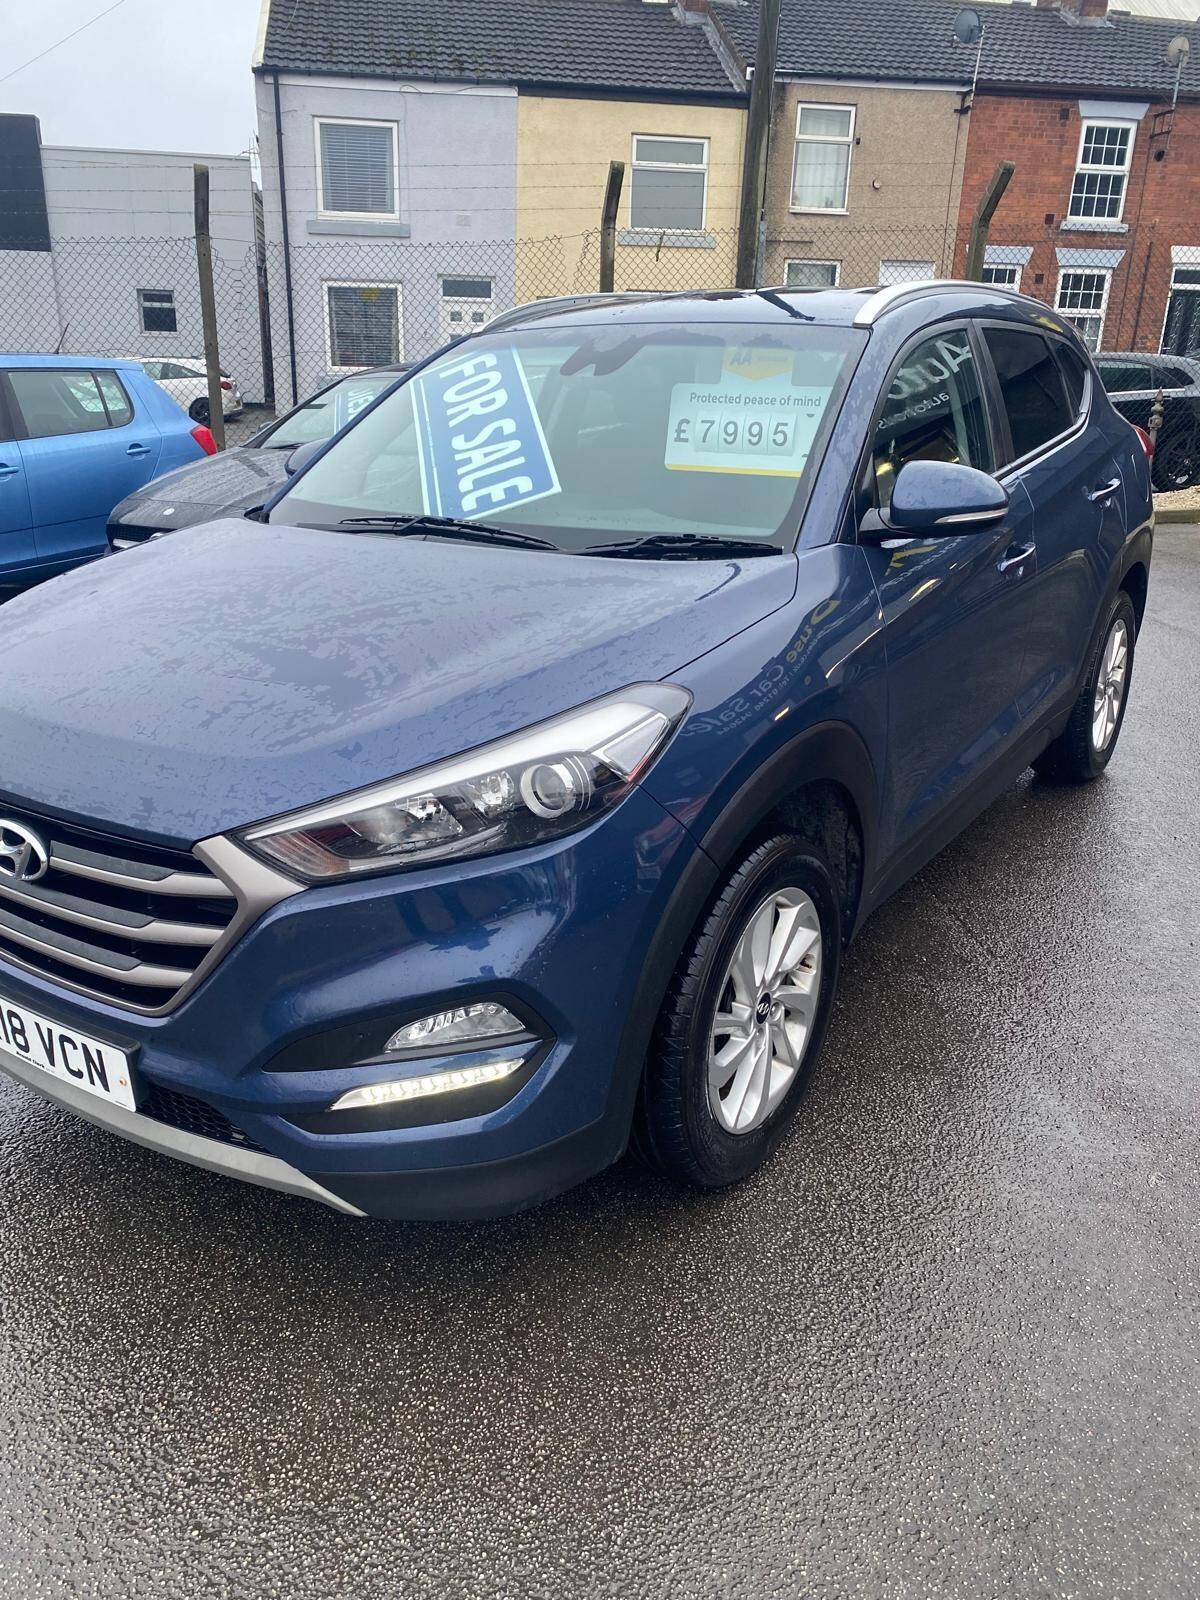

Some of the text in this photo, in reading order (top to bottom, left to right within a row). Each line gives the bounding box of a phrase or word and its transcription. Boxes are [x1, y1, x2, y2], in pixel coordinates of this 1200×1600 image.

[439, 351, 533, 511] FOR SALE
[690, 392, 822, 407] Protected peace of mind
[0, 1005, 30, 1053] 18
[34, 1021, 110, 1093] VCN
